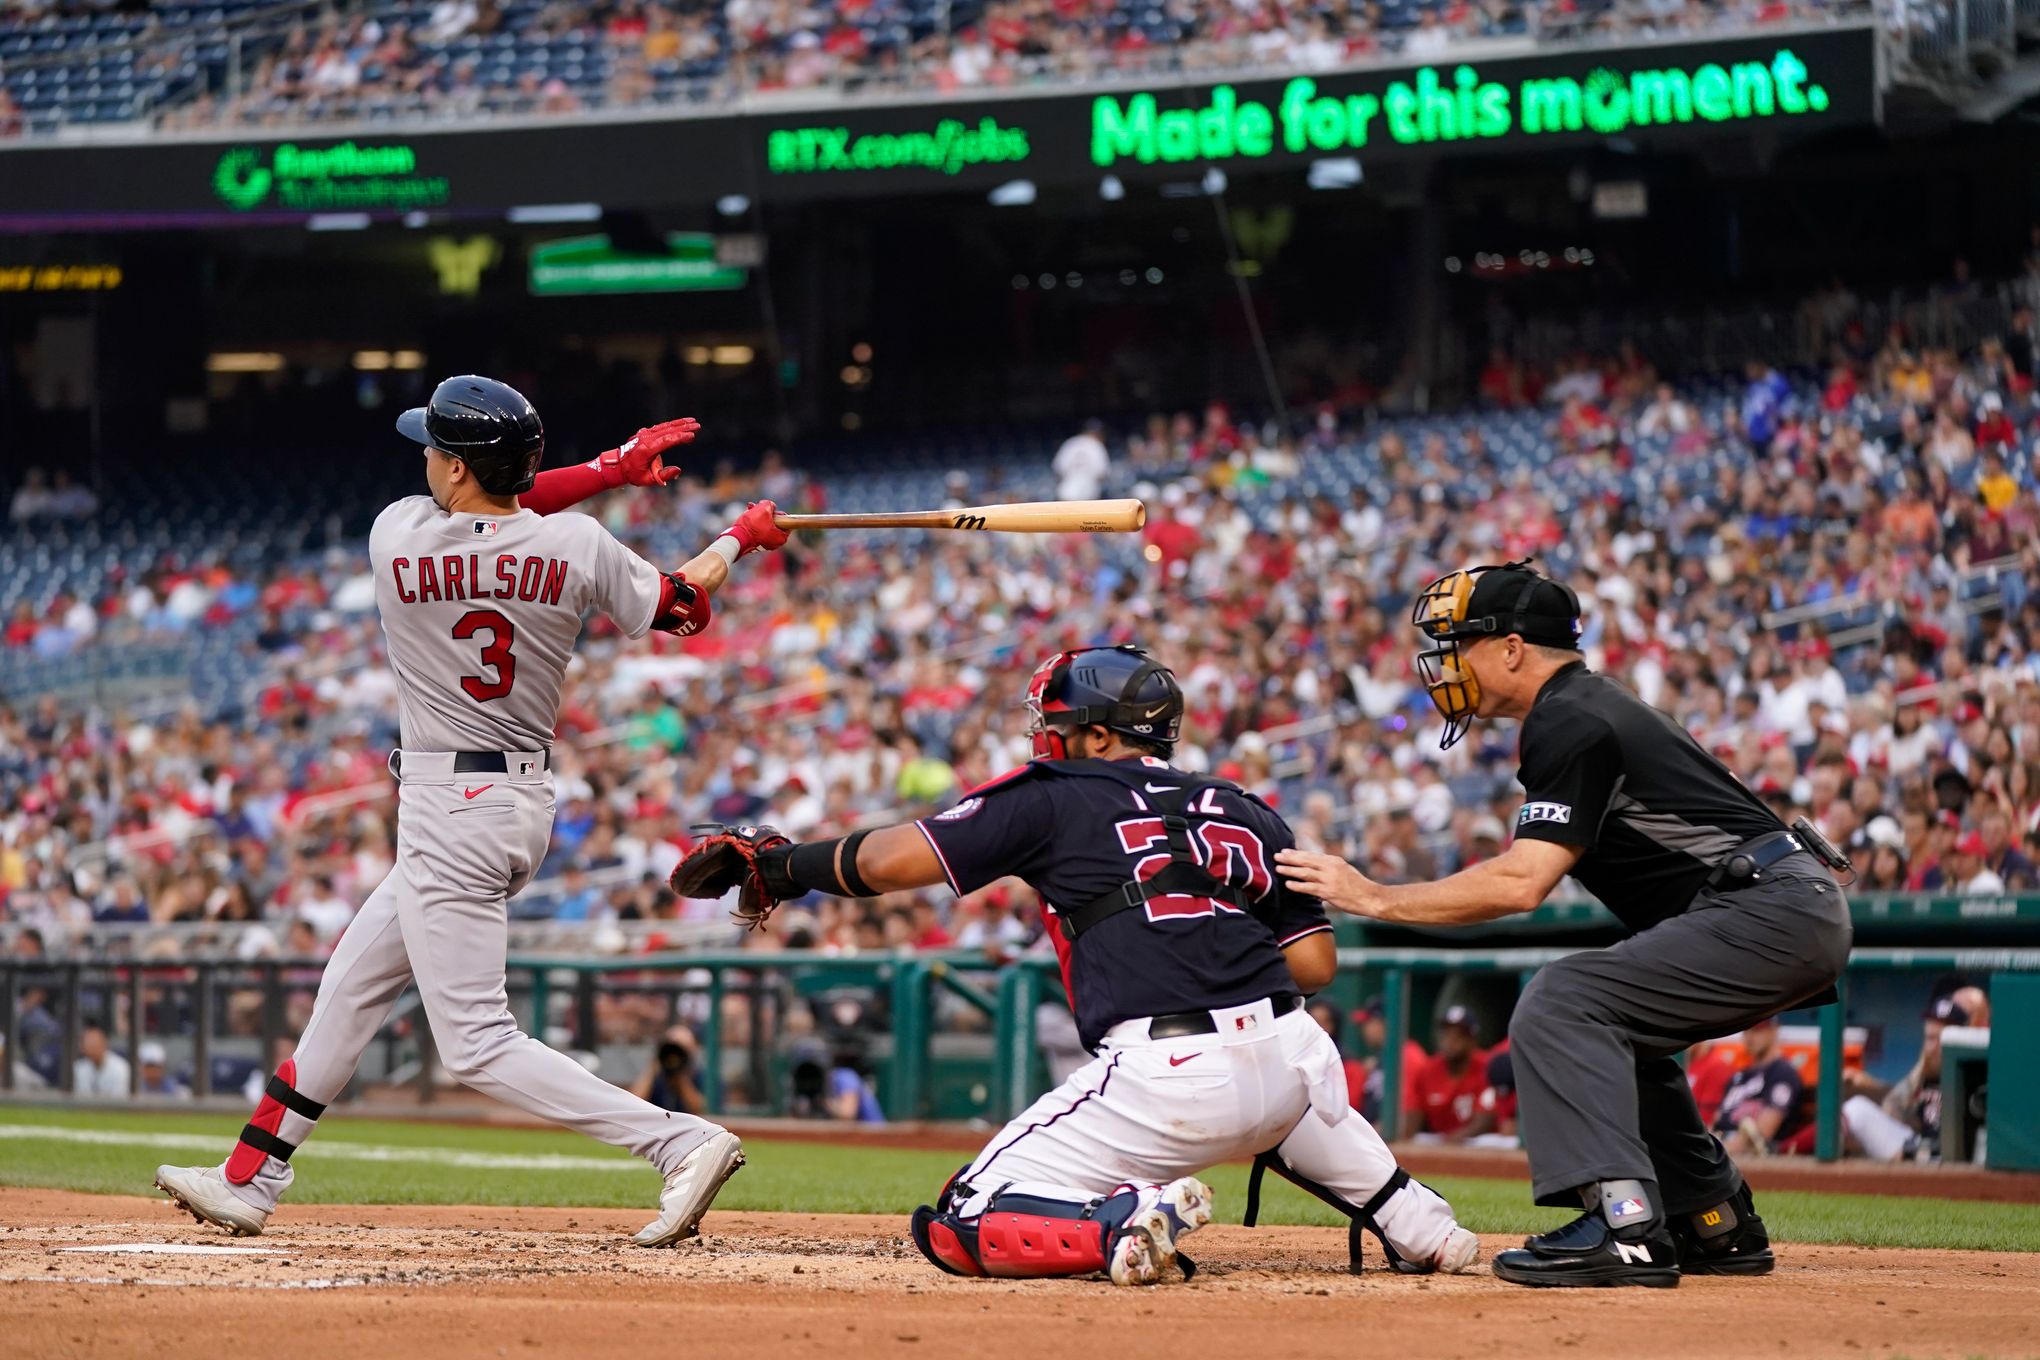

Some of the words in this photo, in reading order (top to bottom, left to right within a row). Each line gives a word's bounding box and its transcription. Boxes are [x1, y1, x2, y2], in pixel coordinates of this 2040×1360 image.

[1091, 83, 1274, 166] Made
[1279, 76, 1379, 151] for
[1383, 64, 1512, 144] this
[1519, 48, 1830, 134] moment.
[767, 116, 1031, 175] RTX.com/jobs
[392, 554, 568, 606] CARLSON
[452, 609, 516, 703] 3
[1529, 804, 1567, 820] FTX
